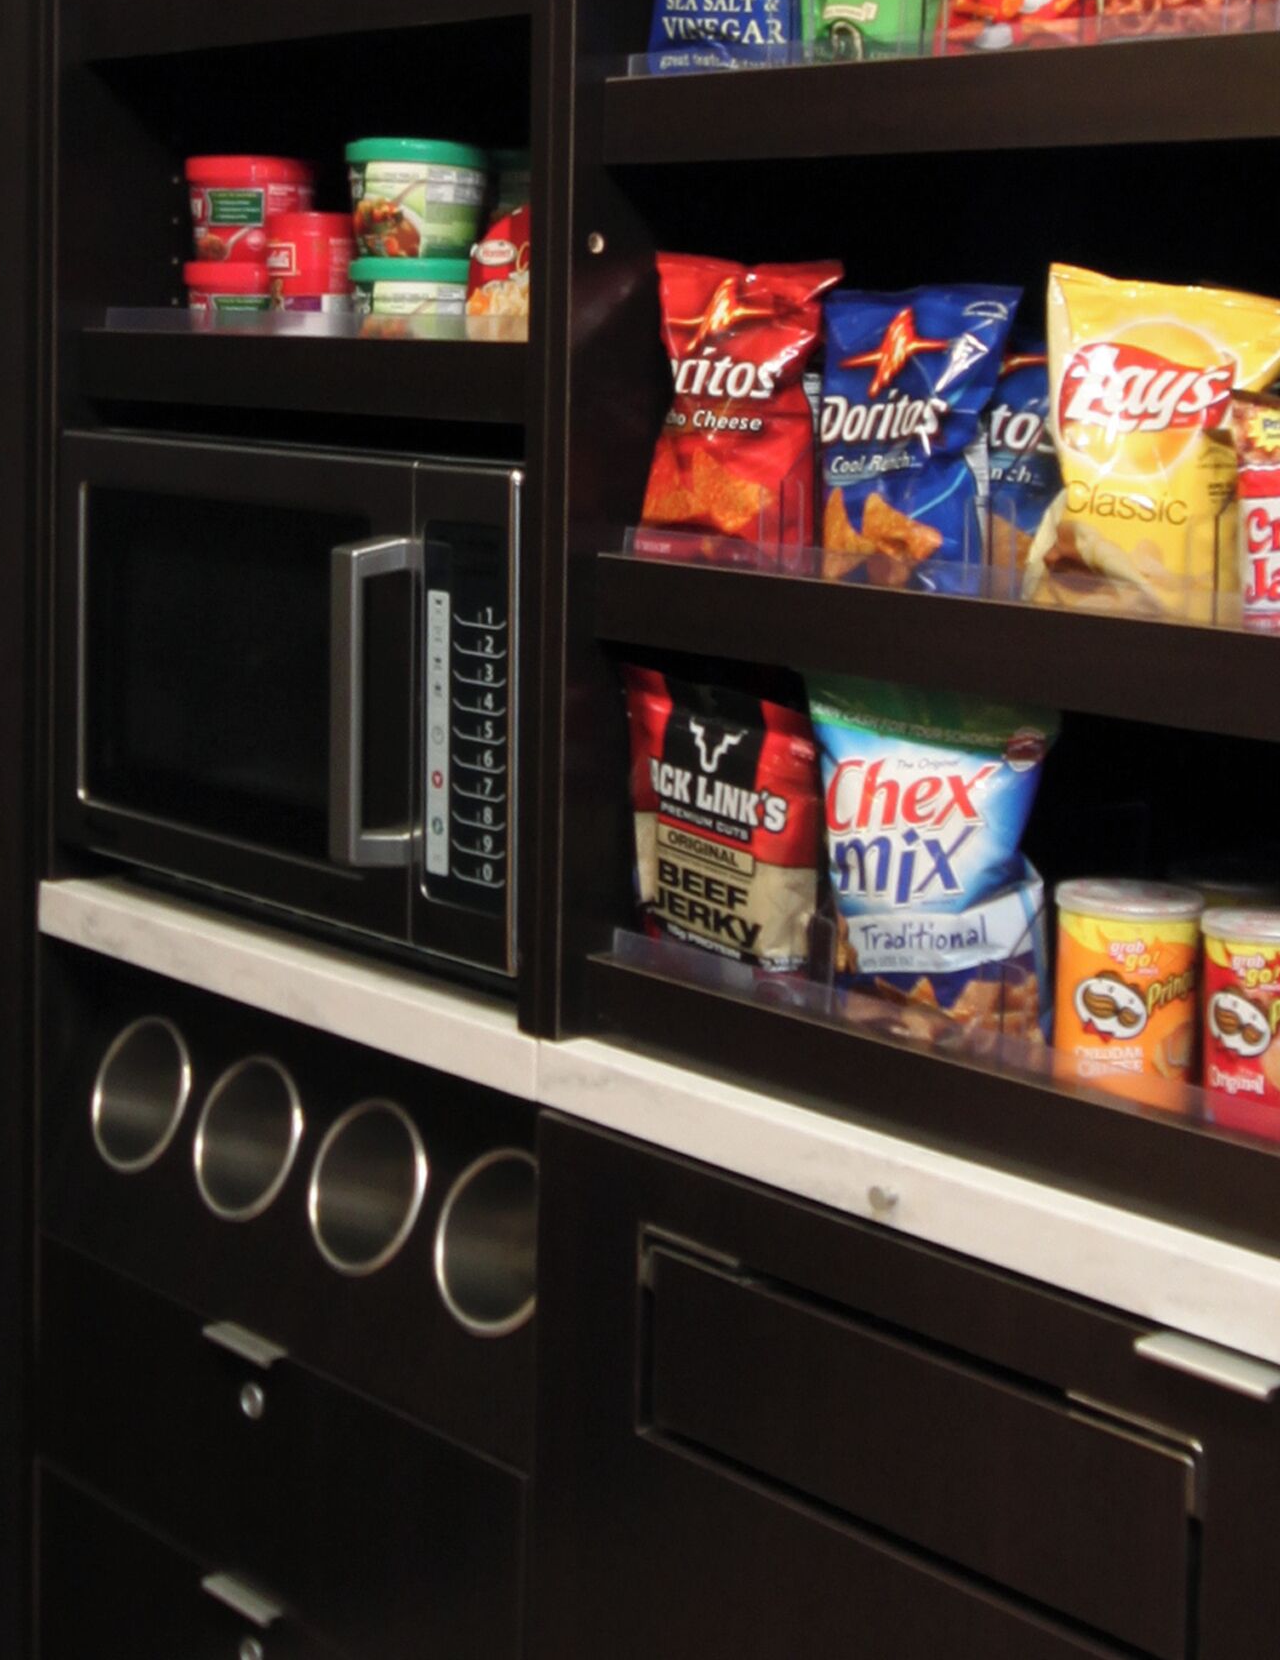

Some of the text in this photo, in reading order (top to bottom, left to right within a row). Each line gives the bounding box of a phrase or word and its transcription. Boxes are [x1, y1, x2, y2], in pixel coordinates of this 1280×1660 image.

[662, 16, 787, 45] VINEGAR
[671, 347, 782, 399] ritos
[1064, 346, 1233, 435] Lay's
[692, 409, 763, 432] Cheese
[822, 387, 949, 443] Doritos
[830, 454, 866, 474] Cool
[1065, 480, 1190, 527] Classic
[482, 607, 493, 624] 1
[482, 636, 493, 653] 2
[482, 664, 493, 682] 3
[482, 694, 493, 711] 4
[482, 721, 493, 739] 5
[482, 750, 493, 768] 6
[896, 756, 961, 772] The Original
[482, 778, 493, 795] 7
[649, 757, 788, 834] ACK LINK'S
[826, 757, 997, 833] Chex
[482, 806, 493, 824] 8
[660, 802, 750, 841] PREMIUM CUTS
[482, 835, 493, 853] 9
[666, 829, 739, 868] ORIGINAL
[482, 864, 493, 882] 0
[835, 827, 974, 904] mix
[656, 857, 749, 911] BEEF
[652, 893, 763, 950] JERKY
[858, 914, 988, 951] Traditional
[1109, 939, 1145, 956] grab
[1124, 952, 1160, 972] go!
[1231, 954, 1266, 971] grab
[1147, 969, 1194, 1015] Pring
